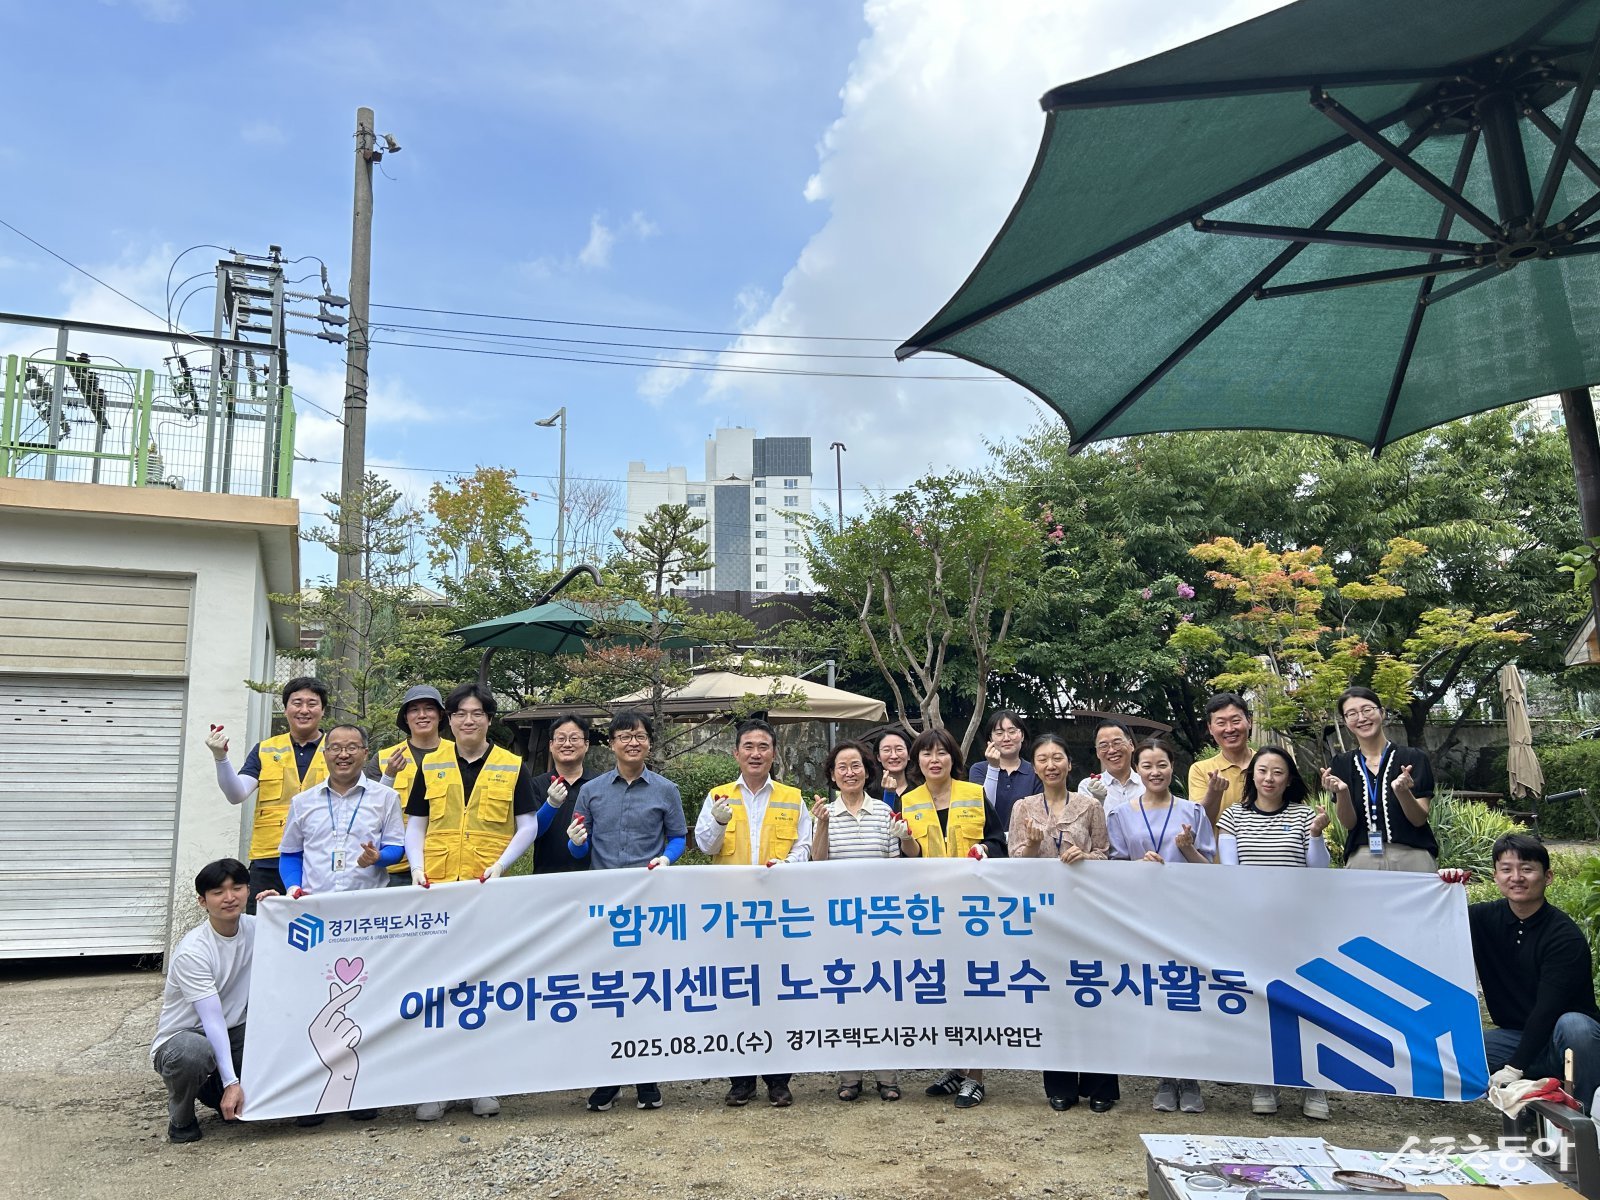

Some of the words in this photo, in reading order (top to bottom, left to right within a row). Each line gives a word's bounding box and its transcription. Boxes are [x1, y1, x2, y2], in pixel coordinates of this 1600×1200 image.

[328, 911, 451, 937] 경기주택도시공사
[588, 903, 687, 948] "함께
[700, 899, 815, 940] 가꾸는
[828, 893, 945, 937] 따뜻한
[957, 892, 1056, 937] 공간"
[399, 962, 761, 1030] 애향아동복지센터
[776, 957, 948, 1005] 노후시설
[963, 958, 1051, 1004] 보수
[1065, 959, 1254, 1015] 봉사활동
[610, 1029, 773, 1060] 2025.08.20.(수)
[785, 1026, 939, 1051] 경기주택도시공사
[944, 1026, 1043, 1049] 택지사업단
